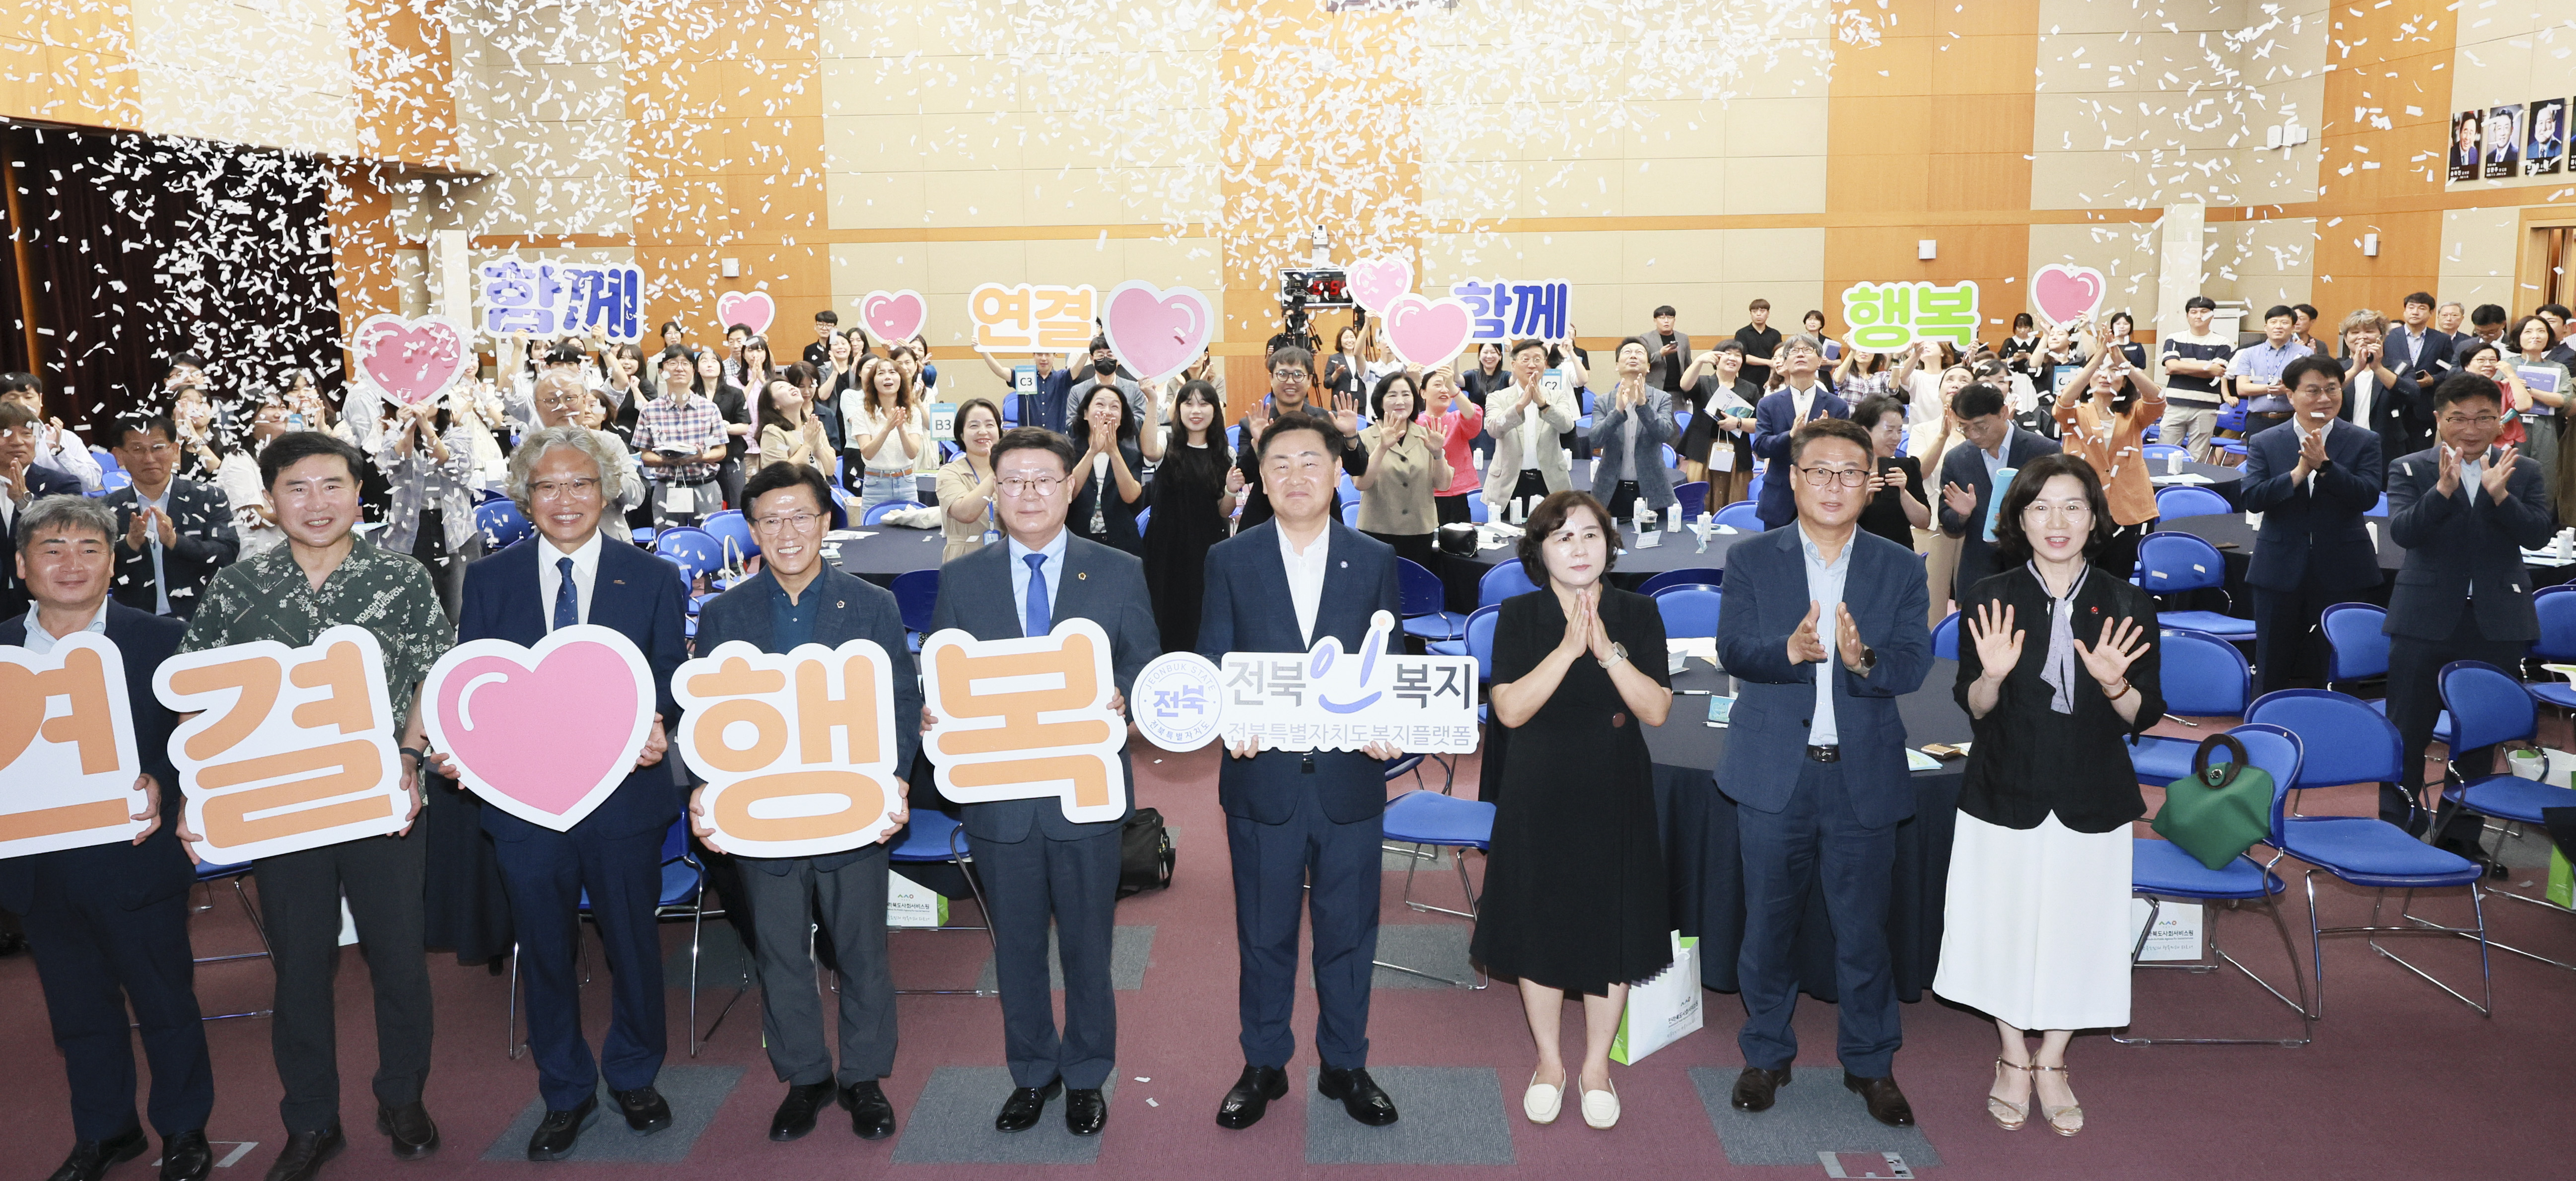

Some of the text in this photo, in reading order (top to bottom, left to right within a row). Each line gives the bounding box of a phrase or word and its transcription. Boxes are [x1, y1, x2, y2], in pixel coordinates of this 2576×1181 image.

[486, 261, 637, 338] 함께
[1454, 281, 1568, 339] 함께
[973, 288, 1090, 347] 연결
[1848, 285, 1975, 347] 행복
[935, 419, 951, 430] B3
[354, 600, 380, 624] NOACH
[1146, 663, 1216, 691] JEONBUK STATE
[1153, 685, 1209, 717] 전북
[1150, 720, 1210, 741] 전북특별자치도
